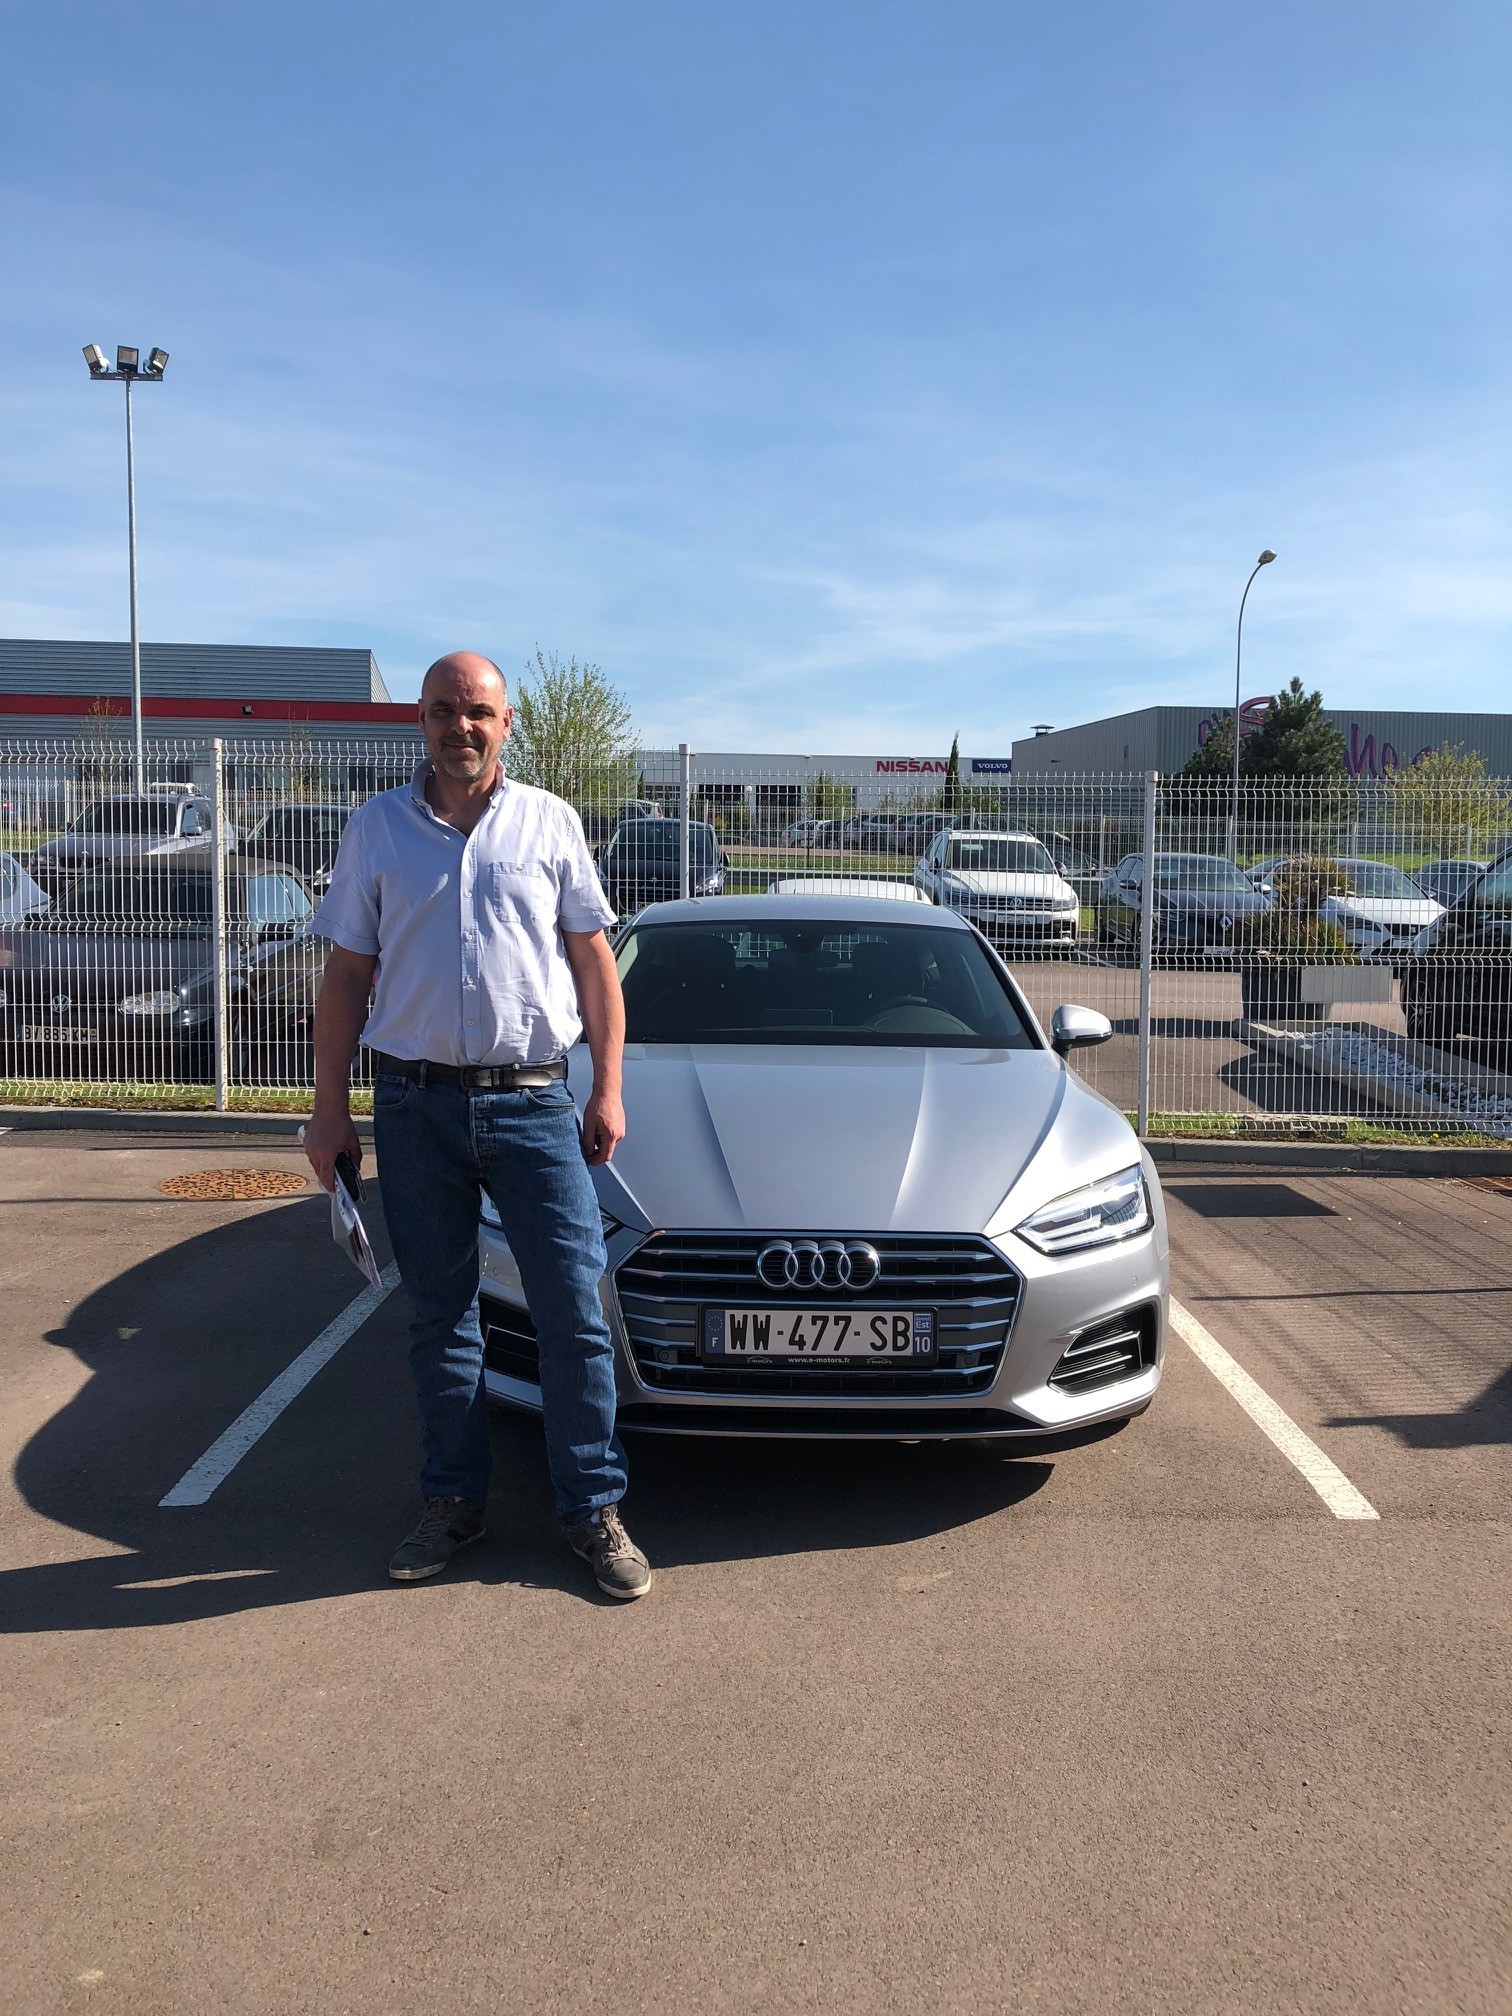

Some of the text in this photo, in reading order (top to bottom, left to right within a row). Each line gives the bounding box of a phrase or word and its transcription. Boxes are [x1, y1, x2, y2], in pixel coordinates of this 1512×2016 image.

[876, 760, 948, 773] NISSAN
[915, 1320, 930, 1329] Est
[712, 1337, 718, 1347] F
[914, 1336, 931, 1353] 10
